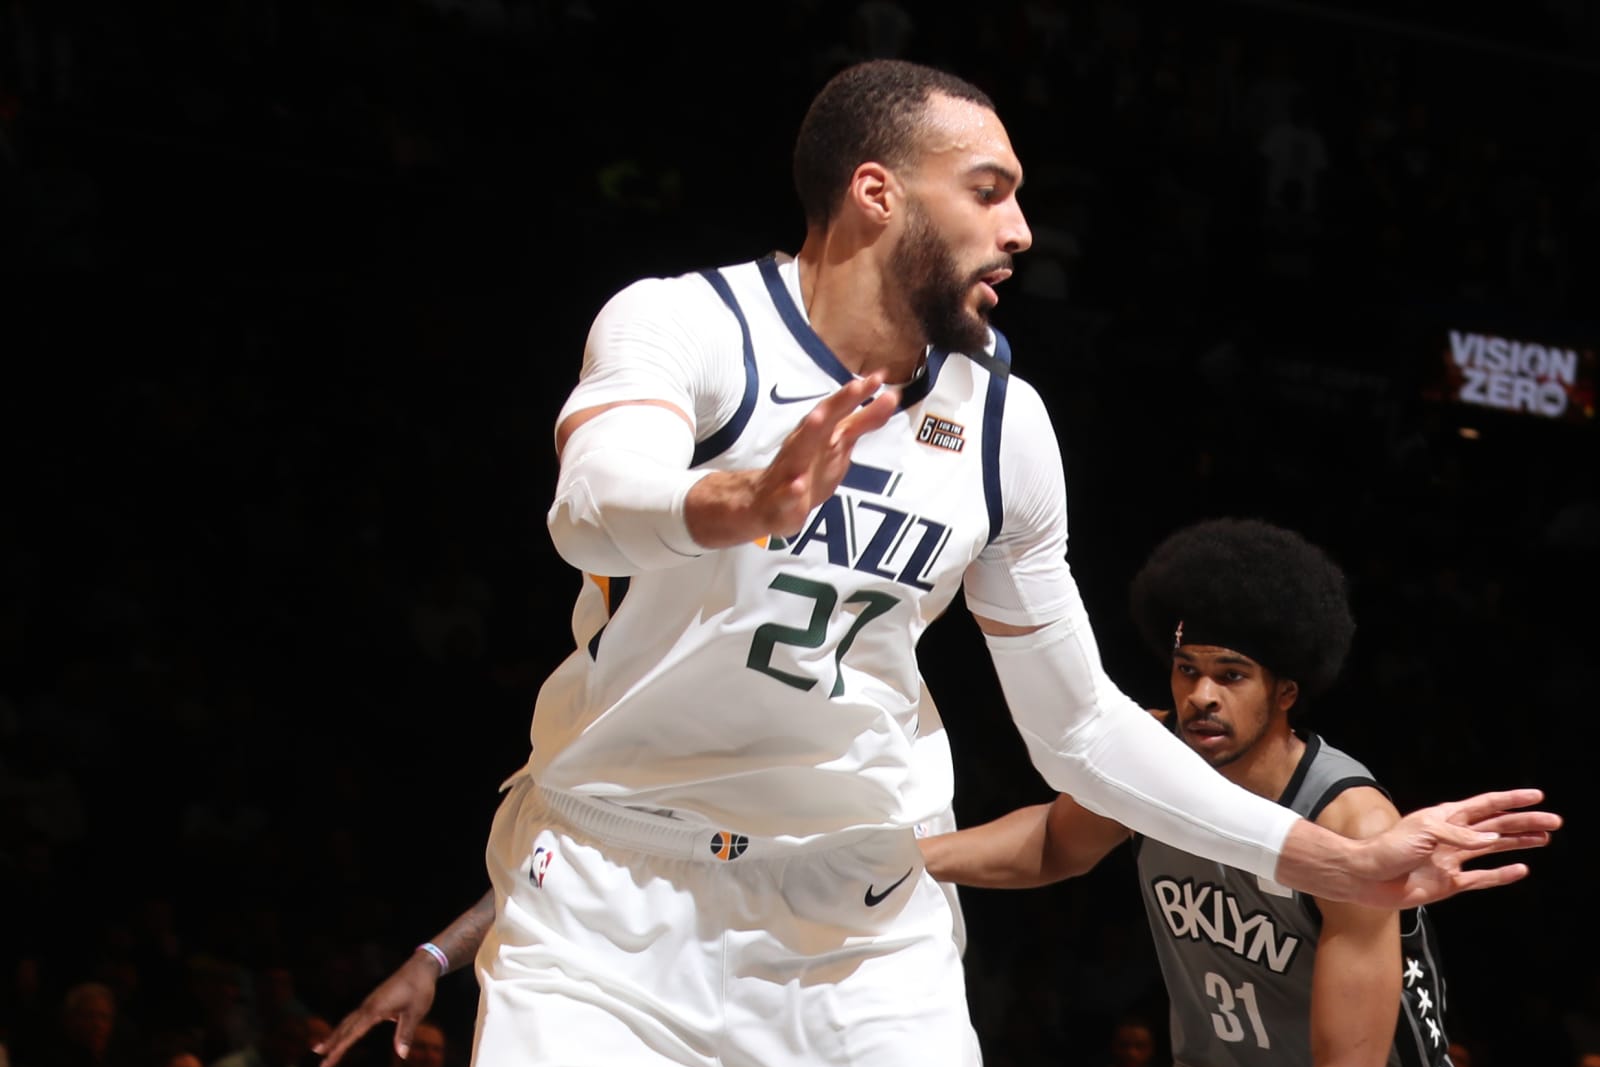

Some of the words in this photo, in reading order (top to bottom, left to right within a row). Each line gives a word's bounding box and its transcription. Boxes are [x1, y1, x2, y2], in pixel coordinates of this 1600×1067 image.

[1448, 329, 1578, 386] VISION
[1459, 367, 1567, 417] ZERO
[919, 416, 936, 442] 5
[932, 432, 963, 451] FIGHT
[746, 573, 901, 700] 27
[1154, 879, 1299, 973] BKLYN
[1204, 971, 1270, 1049] 31
